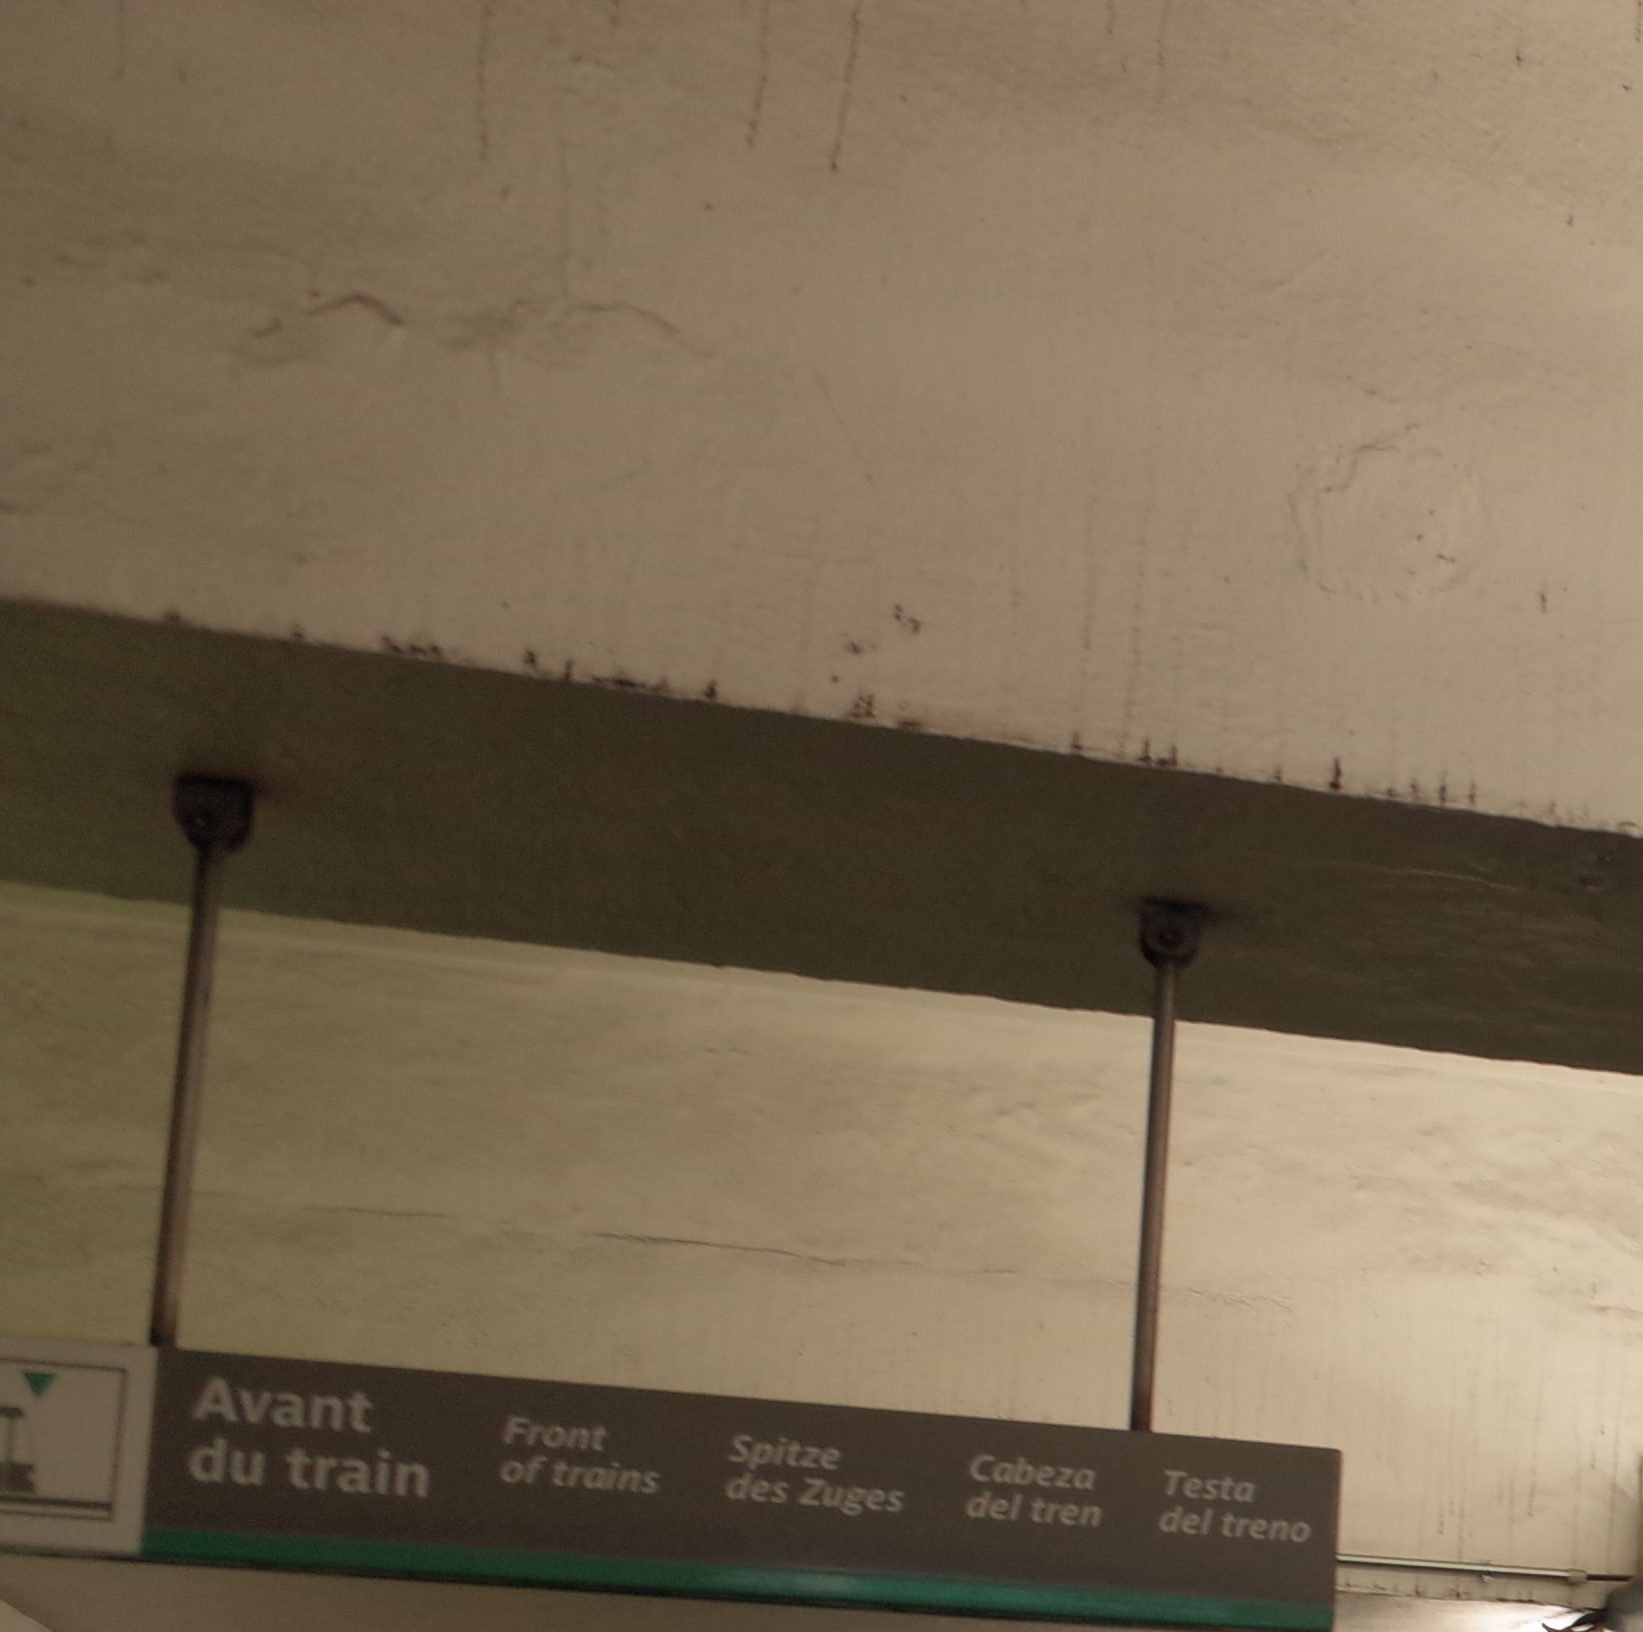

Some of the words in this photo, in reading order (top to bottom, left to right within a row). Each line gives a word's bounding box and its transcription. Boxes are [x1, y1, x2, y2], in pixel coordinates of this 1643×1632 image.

[192, 1376, 374, 1433] Avant
[503, 1415, 609, 1452] Front
[188, 1437, 265, 1486] du
[286, 1448, 430, 1498] train
[728, 1434, 842, 1471] Spitze
[500, 1456, 540, 1485] of
[550, 1461, 661, 1495] trains
[968, 1454, 1097, 1491] Cabeza
[1164, 1470, 1256, 1503] Testa
[724, 1473, 788, 1504] des
[798, 1477, 905, 1516] Zuges
[965, 1492, 1020, 1522] del
[1030, 1498, 1103, 1528] tren
[1158, 1507, 1212, 1536] del
[1220, 1512, 1312, 1543] treno
